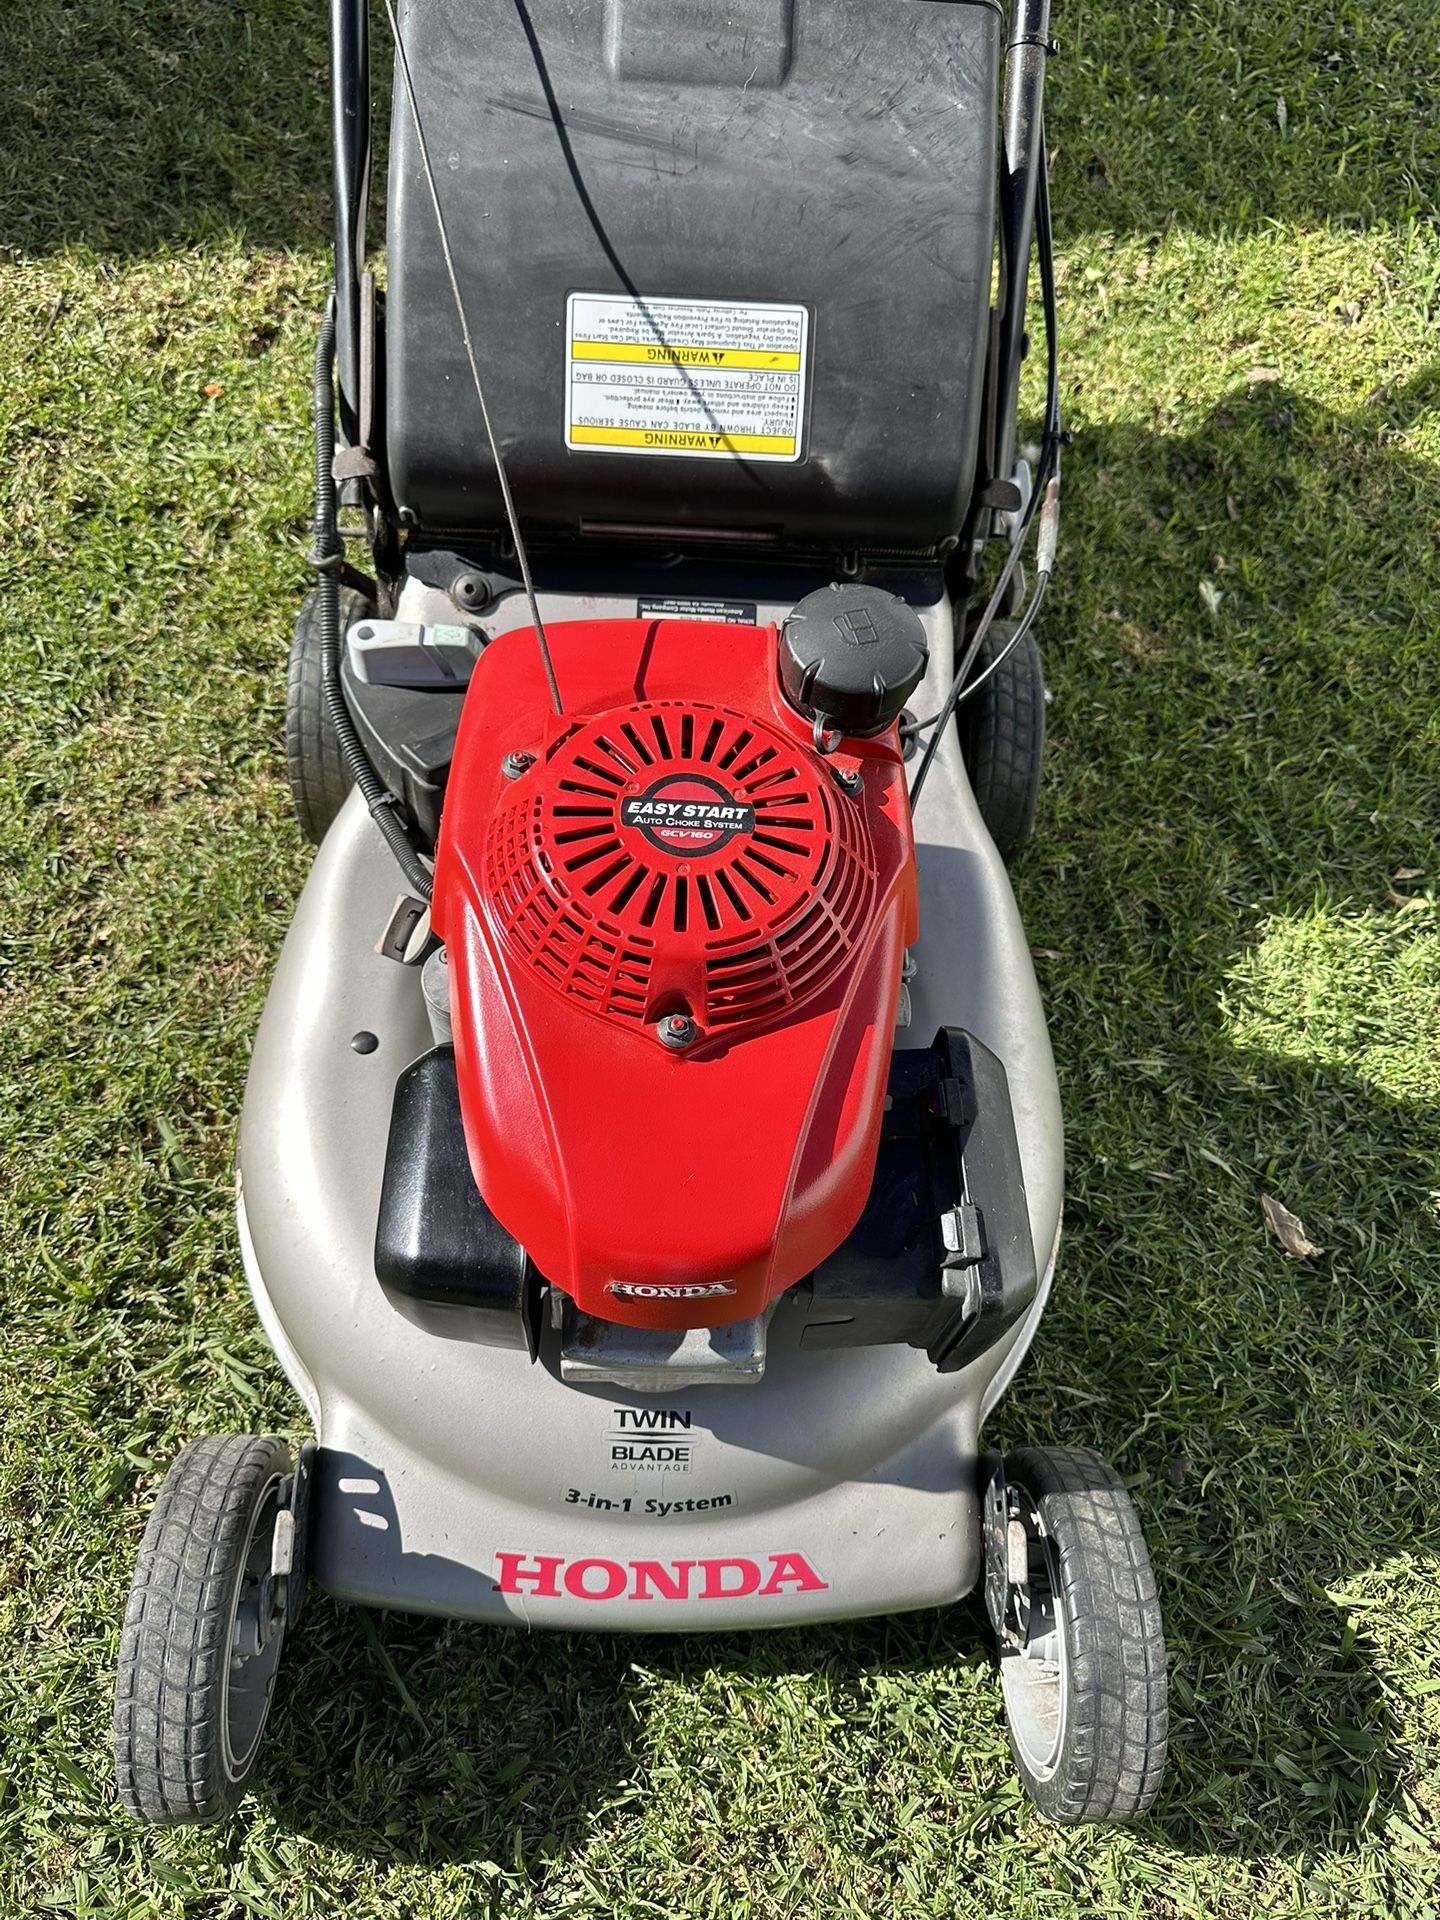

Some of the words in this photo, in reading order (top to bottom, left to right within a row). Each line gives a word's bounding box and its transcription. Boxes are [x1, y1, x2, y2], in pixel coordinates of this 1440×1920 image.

[673, 314, 708, 322] Prevention
[733, 317, 759, 325] Relating
[762, 319, 799, 327] Regulations
[706, 340, 741, 348] Equipment
[766, 343, 797, 351] Operation
[647, 349, 709, 362] WARNING
[576, 373, 592, 381] BAG
[610, 375, 643, 383] CLOSED
[657, 377, 685, 385] GUARD
[749, 374, 774, 382] PLACE
[688, 379, 721, 387] UNLESS
[724, 381, 761, 389] OPERATE
[764, 410, 788, 418] Inspect
[578, 417, 614, 426] SERIOUS
[619, 419, 646, 427] CAUSE
[651, 420, 668, 428] CAN
[762, 418, 793, 426] INJURY.
[673, 422, 700, 430] BLADE
[704, 423, 716, 431] BY
[720, 424, 756, 433] THROWN
[761, 426, 793, 435] OBJECT
[644, 433, 706, 446] WARNING
[627, 802, 683, 815] EASY
[683, 806, 748, 819] START
[610, 1283, 729, 1297] HONDA
[614, 1410, 691, 1428] TWIN
[612, 1447, 690, 1461] BLADE
[611, 1463, 689, 1472] ADVANTAGE
[565, 1489, 632, 1511] 3-in-1
[645, 1494, 732, 1516] System
[492, 1552, 829, 1600] HONDA
